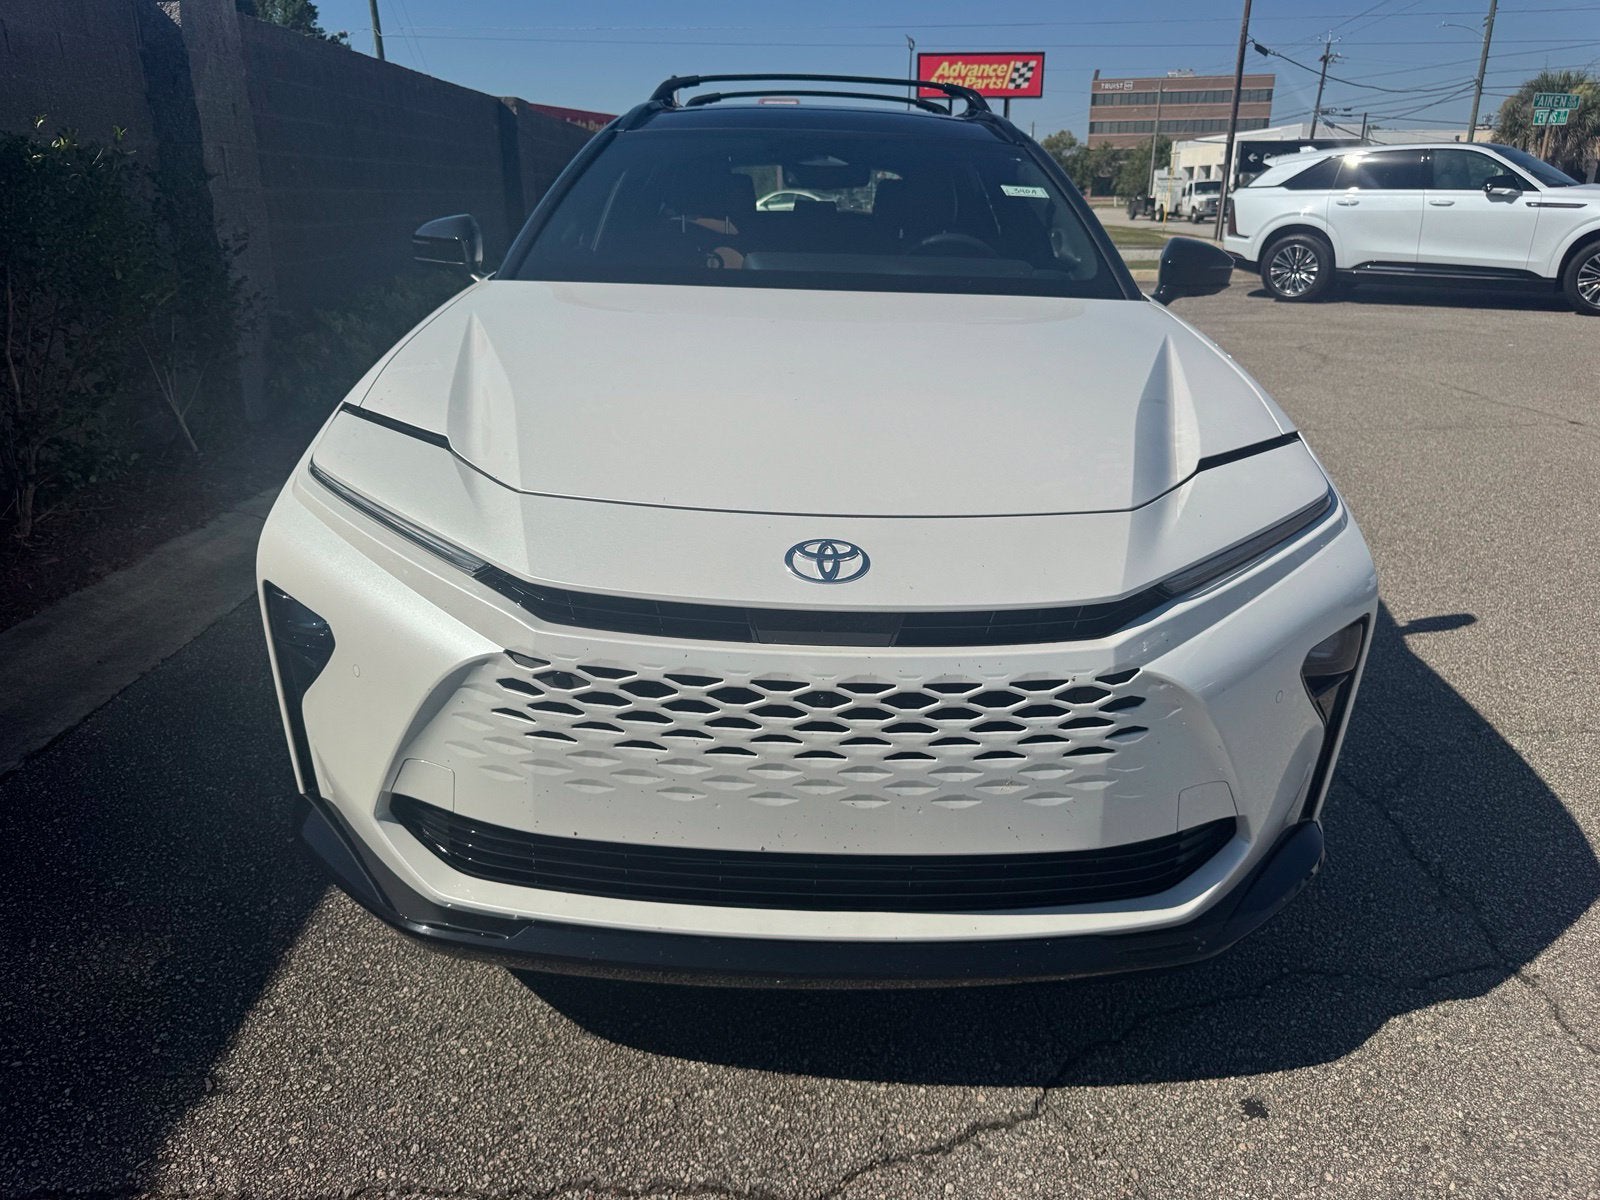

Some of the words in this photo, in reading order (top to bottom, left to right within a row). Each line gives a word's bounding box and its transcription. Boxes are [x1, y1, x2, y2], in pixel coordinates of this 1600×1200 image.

[934, 61, 1007, 77] Advance
[964, 77, 1004, 89] Parts
[1537, 95, 1567, 107] AIKEN
